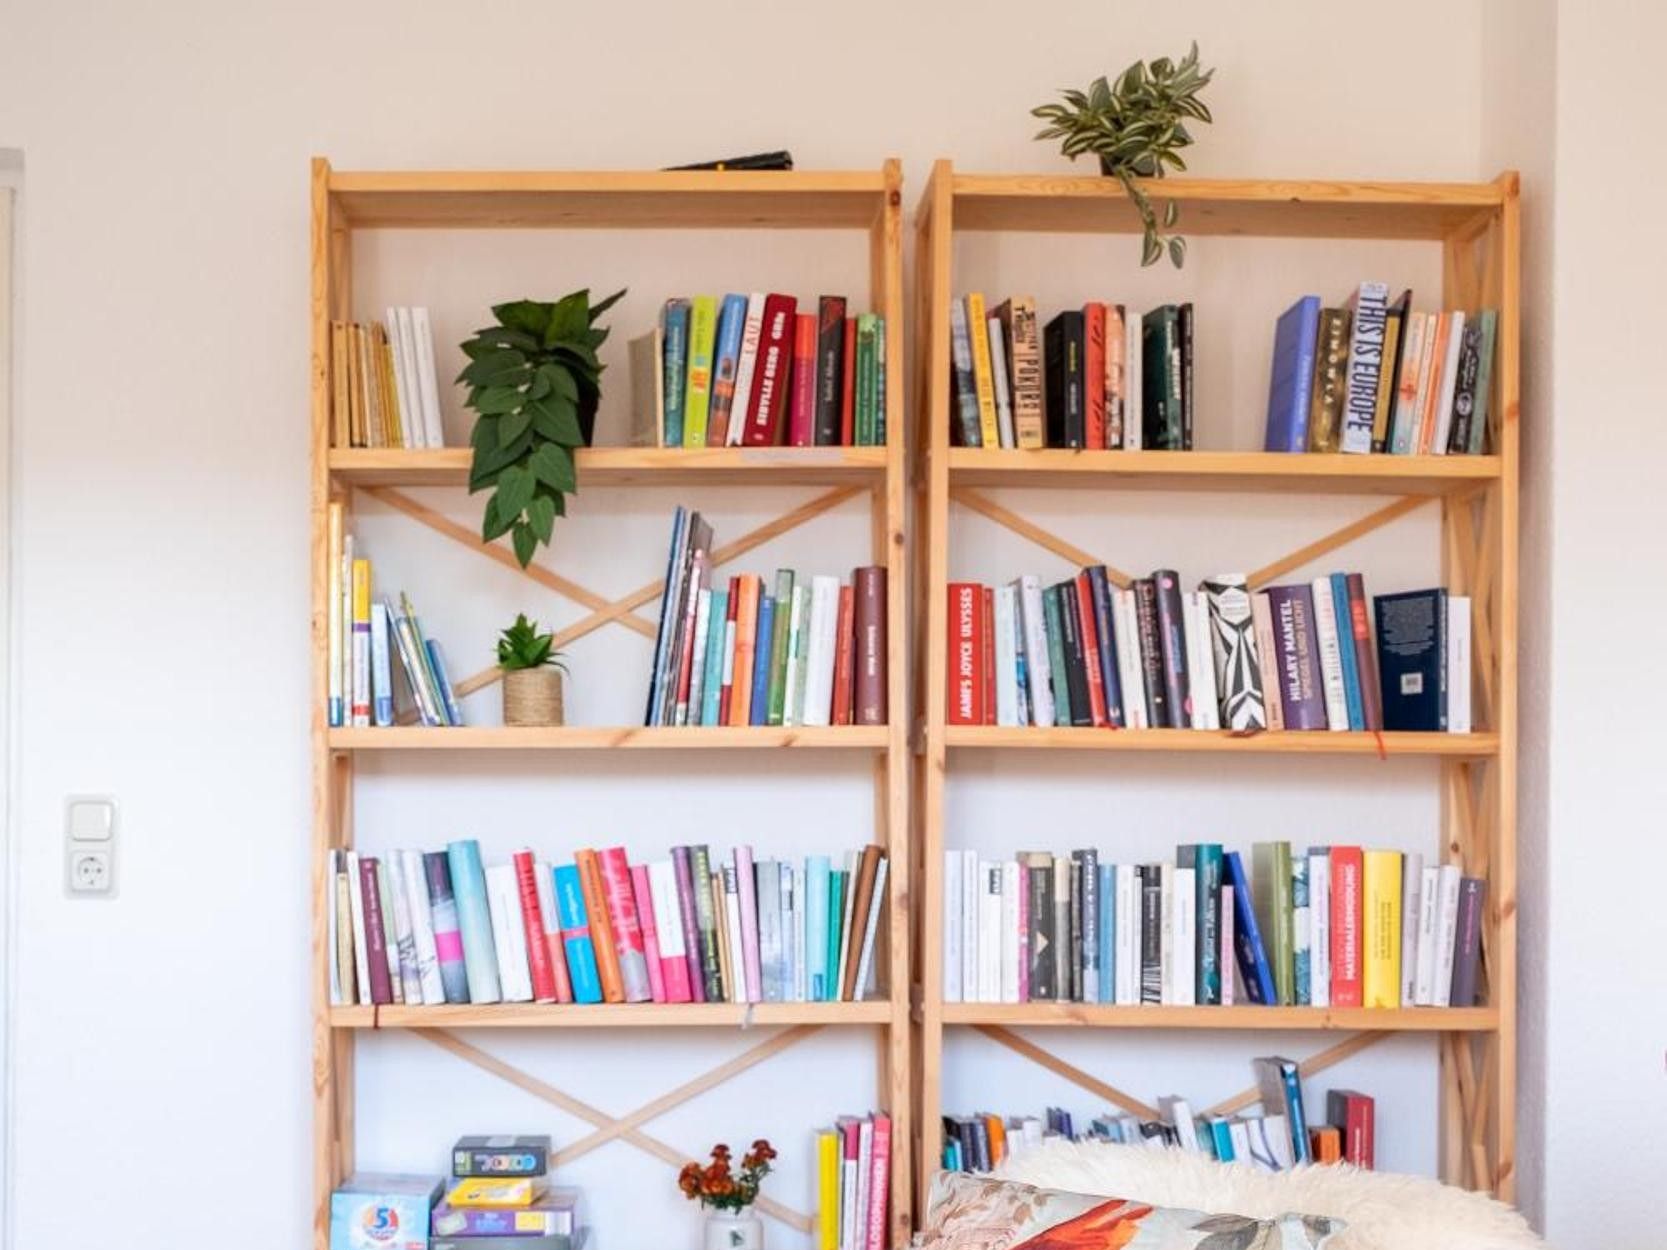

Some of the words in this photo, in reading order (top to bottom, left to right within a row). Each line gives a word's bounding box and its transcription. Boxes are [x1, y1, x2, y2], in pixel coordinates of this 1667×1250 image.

[1357, 296, 1389, 337] THIS
[764, 346, 780, 378] BERG
[1324, 318, 1342, 405] ZIMOWLA
[1355, 339, 1384, 359] IS
[756, 379, 774, 426] SIBYLLE
[1347, 361, 1381, 432] EUROPE
[960, 587, 973, 638] ULYSSES
[1280, 600, 1297, 652] MANTEL
[960, 640, 973, 678] JOYCE
[1286, 654, 1302, 702] HILARY
[960, 679, 973, 720] JAMES
[373, 1207, 390, 1230] 5
